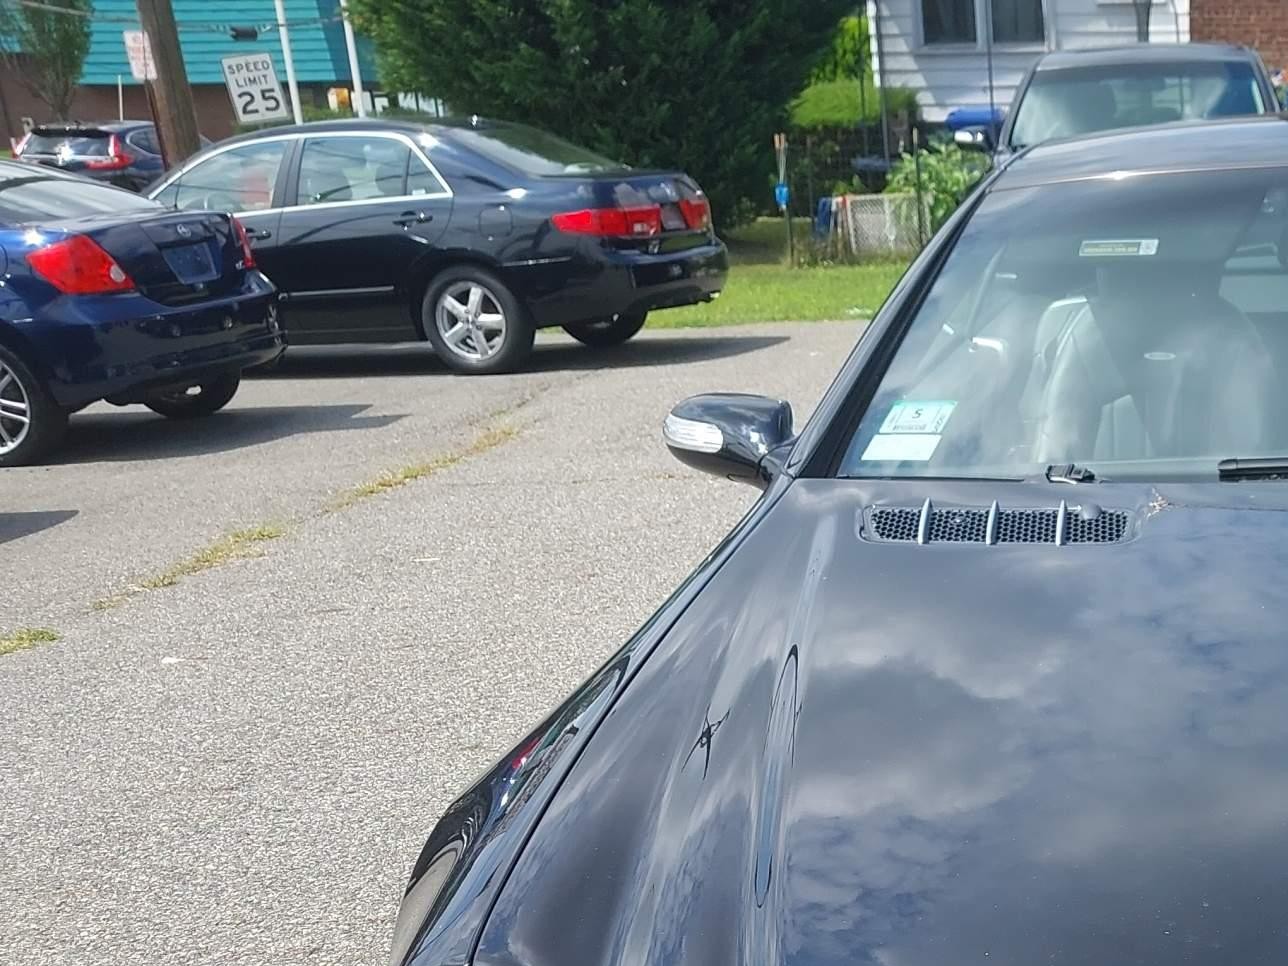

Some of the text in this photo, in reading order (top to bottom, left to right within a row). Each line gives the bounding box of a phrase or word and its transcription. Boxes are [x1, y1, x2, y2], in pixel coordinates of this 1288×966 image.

[227, 60, 270, 75] SPEED
[235, 74, 268, 88] LIMIT
[237, 88, 280, 115] 25
